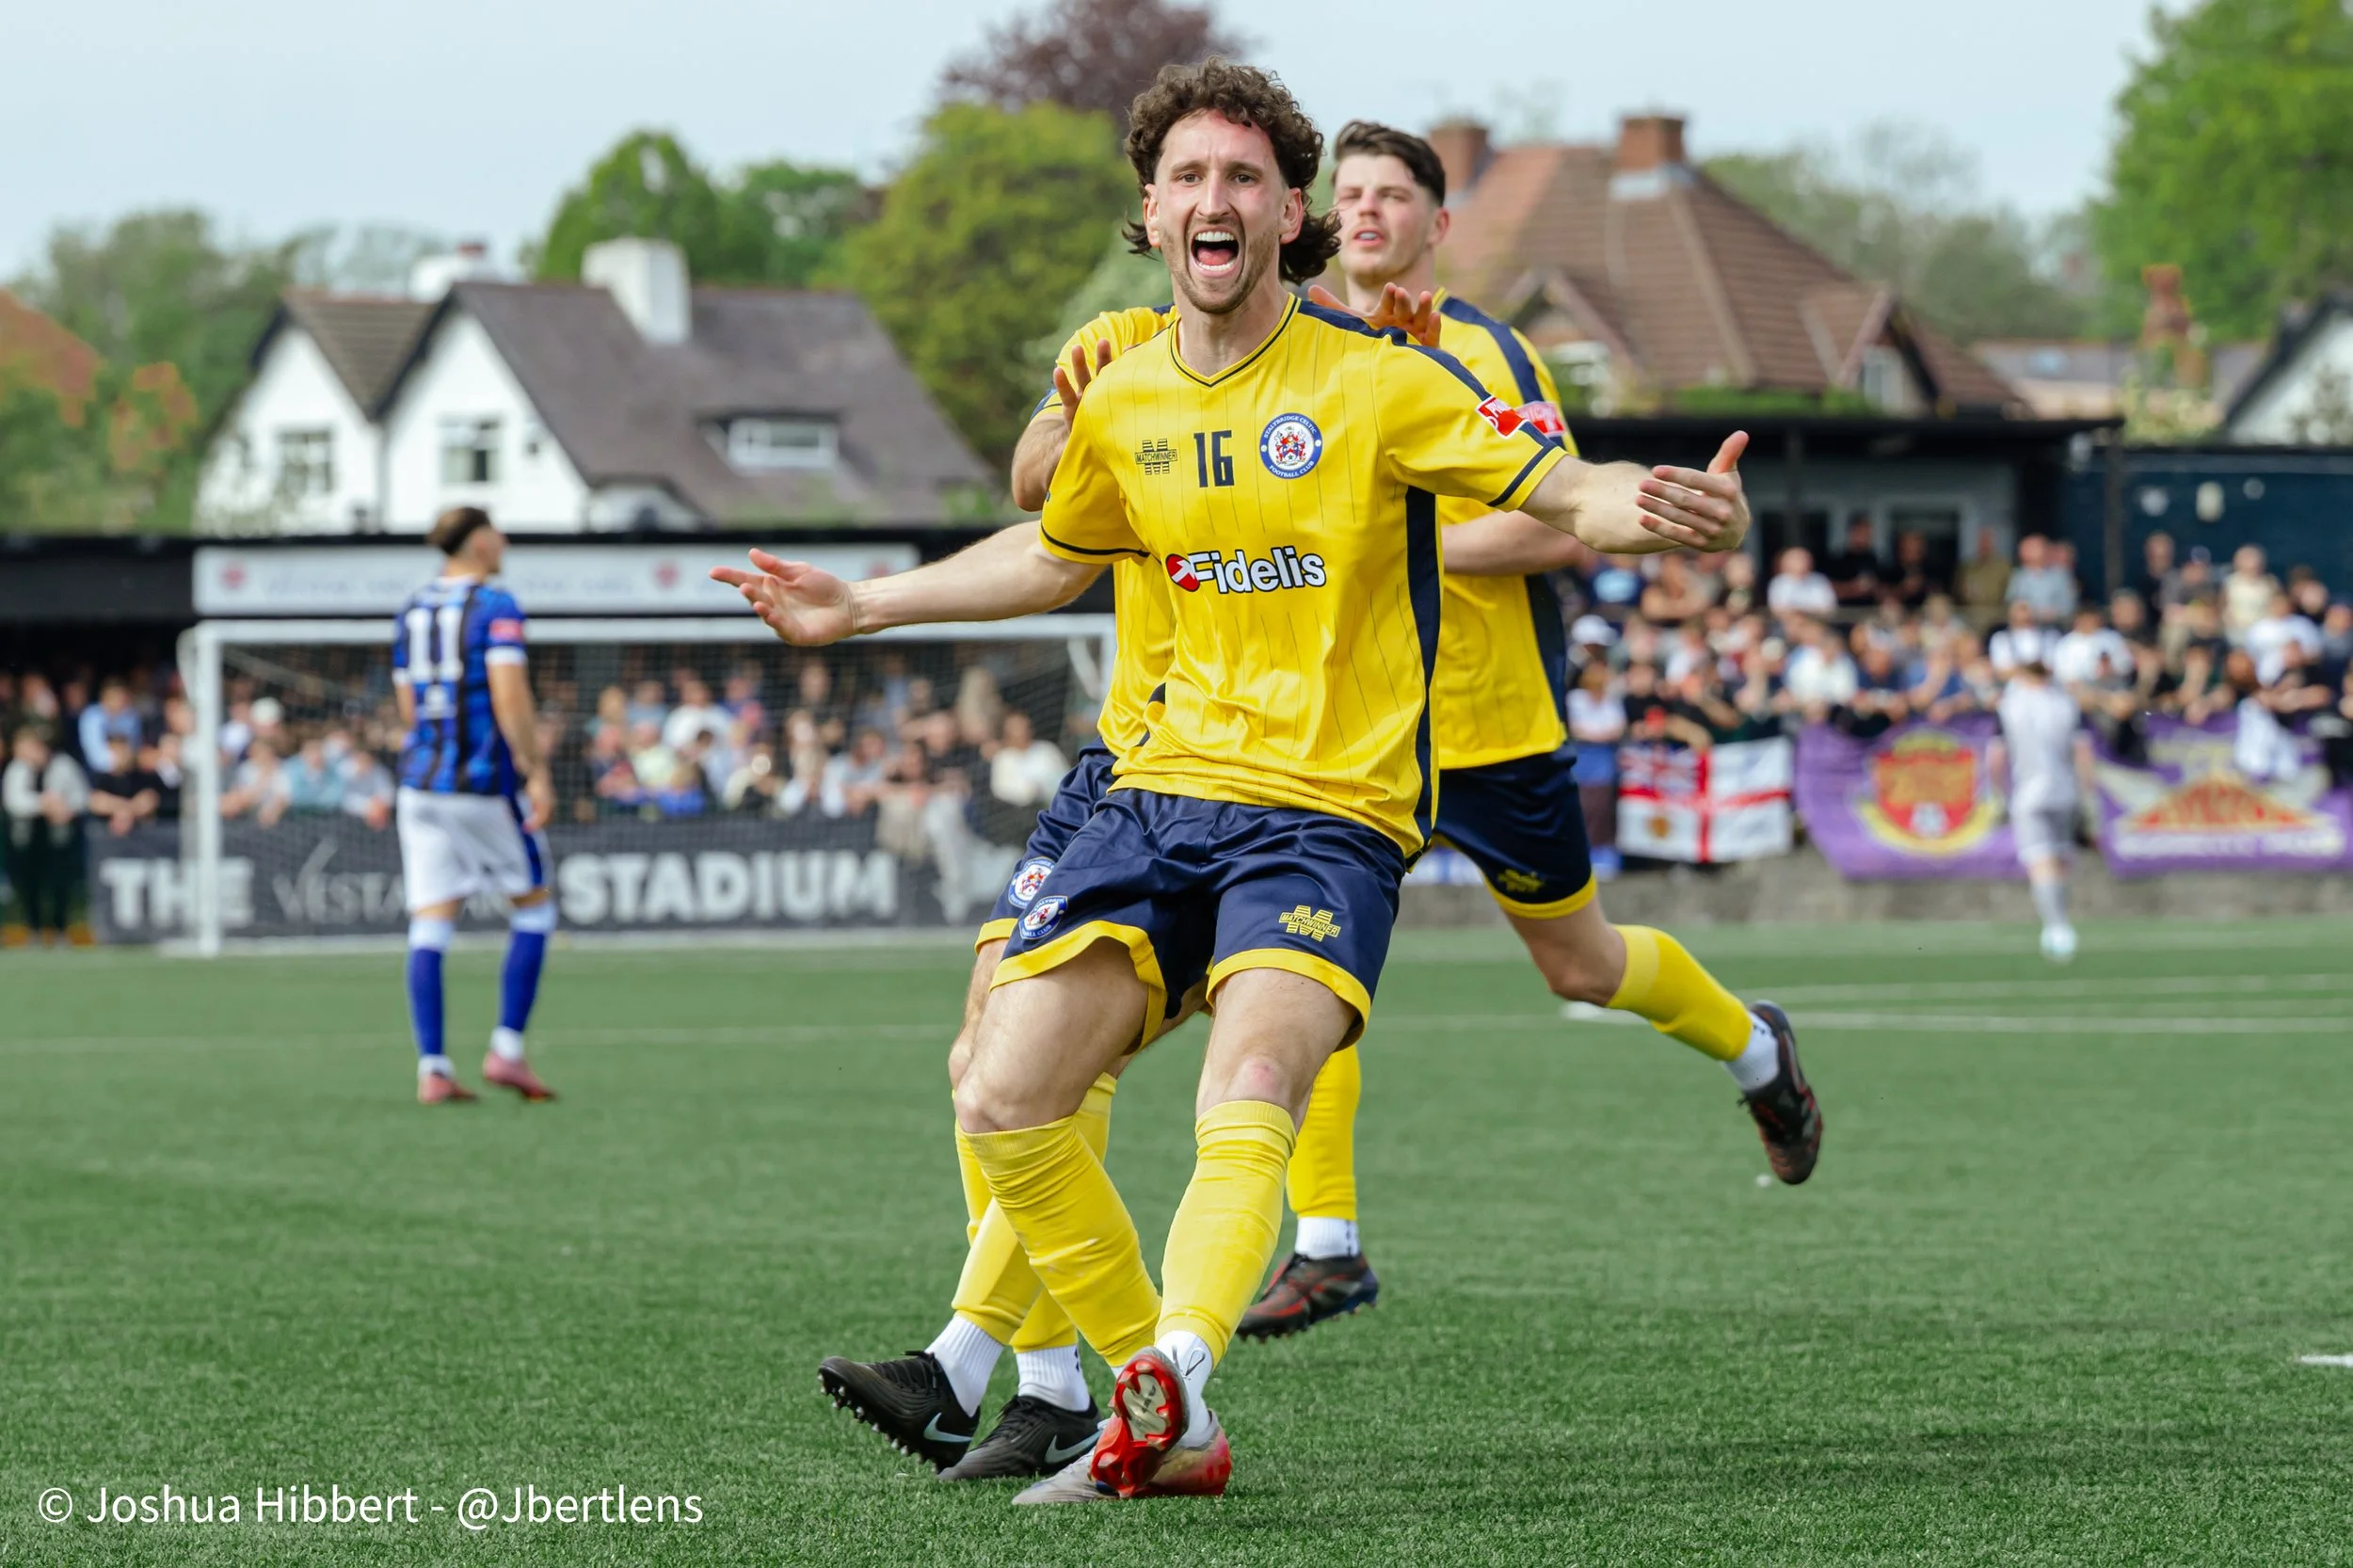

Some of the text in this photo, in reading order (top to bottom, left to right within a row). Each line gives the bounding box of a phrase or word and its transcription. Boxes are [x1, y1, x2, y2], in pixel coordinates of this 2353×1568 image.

[1263, 415, 1318, 439] STALYBRIDGE CELTIC
[1136, 451, 1176, 462] MATCHWINNER
[1193, 429, 1235, 488] 16
[1269, 460, 1315, 478] FOOTBALL CLUB
[1187, 545, 1327, 594] Fidelis
[404, 606, 465, 683] 11
[558, 850, 899, 925] STADIUM
[1281, 914, 1339, 936] MATCHWINNER
